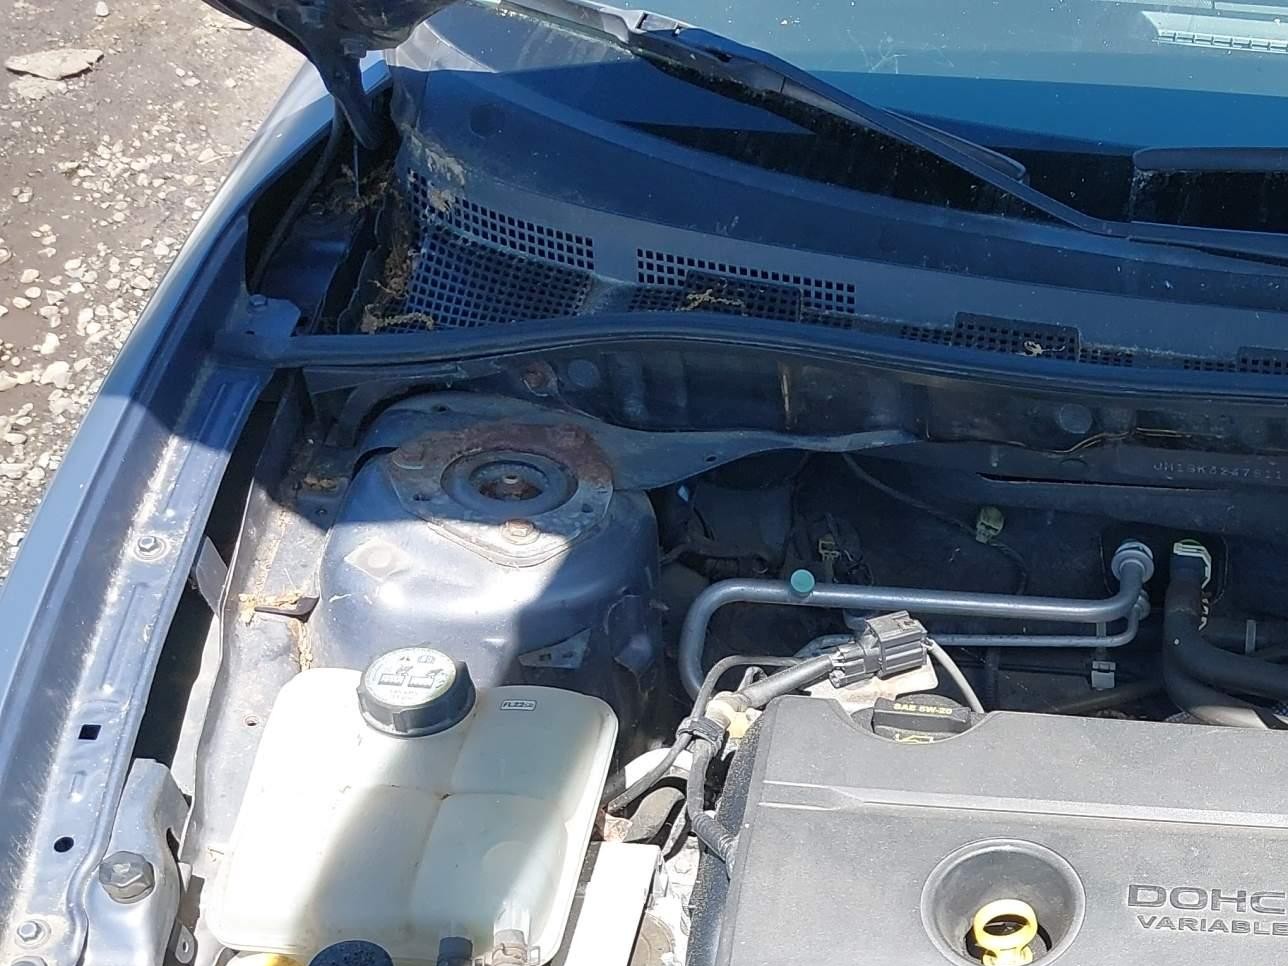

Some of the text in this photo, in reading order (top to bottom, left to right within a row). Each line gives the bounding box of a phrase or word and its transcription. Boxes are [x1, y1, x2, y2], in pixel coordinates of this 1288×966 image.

[893, 702, 953, 715] SAE 5W-20
[1127, 884, 1286, 915] DOHC
